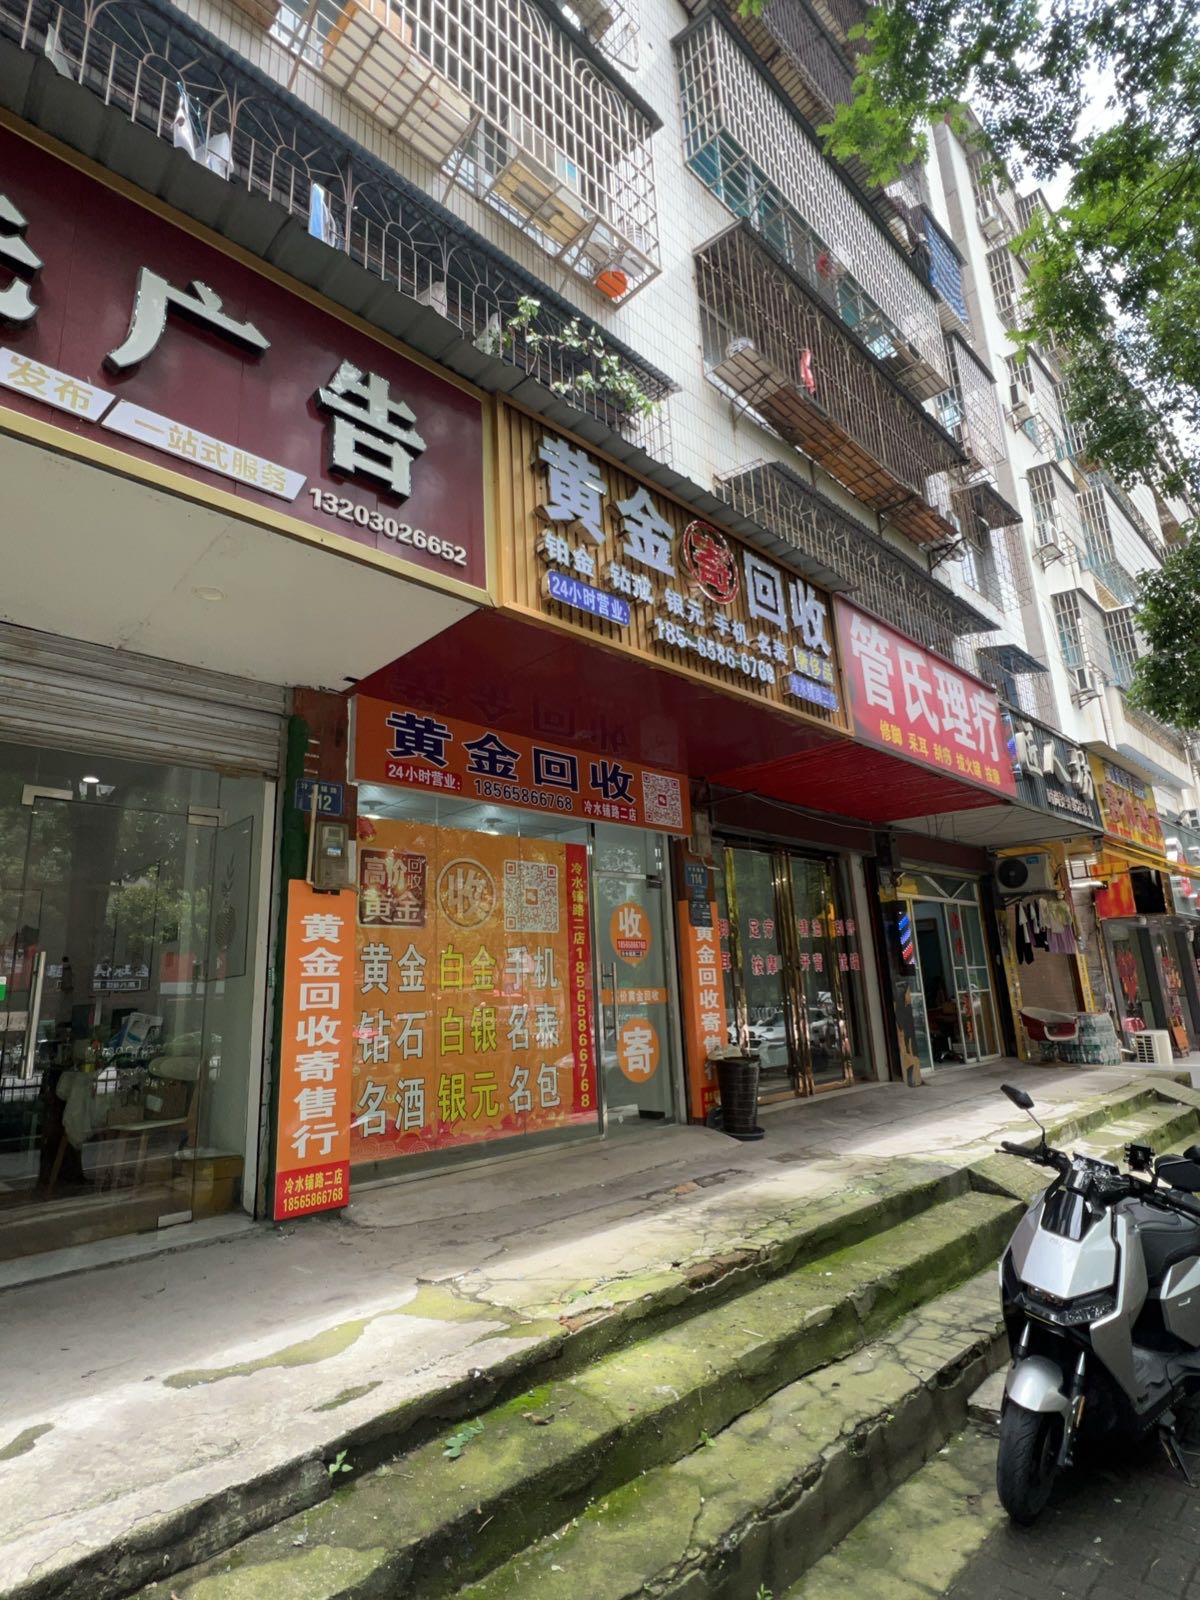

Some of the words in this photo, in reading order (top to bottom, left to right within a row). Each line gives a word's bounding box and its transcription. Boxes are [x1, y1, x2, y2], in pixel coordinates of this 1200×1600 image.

[7, 355, 93, 411] 发布
[134, 418, 287, 492] 一站式服务
[309, 487, 468, 566] 13203026652
[714, 612, 750, 646] 手机
[850, 613, 1000, 762] 管氏理疗
[386, 711, 634, 803] 黄金回收
[474, 778, 573, 811] 18565866768
[619, 907, 642, 938] 收
[361, 943, 427, 994] 黄金
[440, 944, 497, 991] 白金
[505, 946, 559, 991] 手机
[291, 913, 344, 1158] 黄金回收寄售行
[359, 1010, 426, 1064] 钻石
[440, 1006, 498, 1056] 白银
[623, 1027, 654, 1074] 寄
[358, 1078, 426, 1138] 名酒
[438, 1071, 500, 1122] 银元
[509, 1062, 561, 1114] 名包
[283, 1187, 343, 1213] 18565866768
[284, 1168, 343, 1194] 冷水铺路二店
